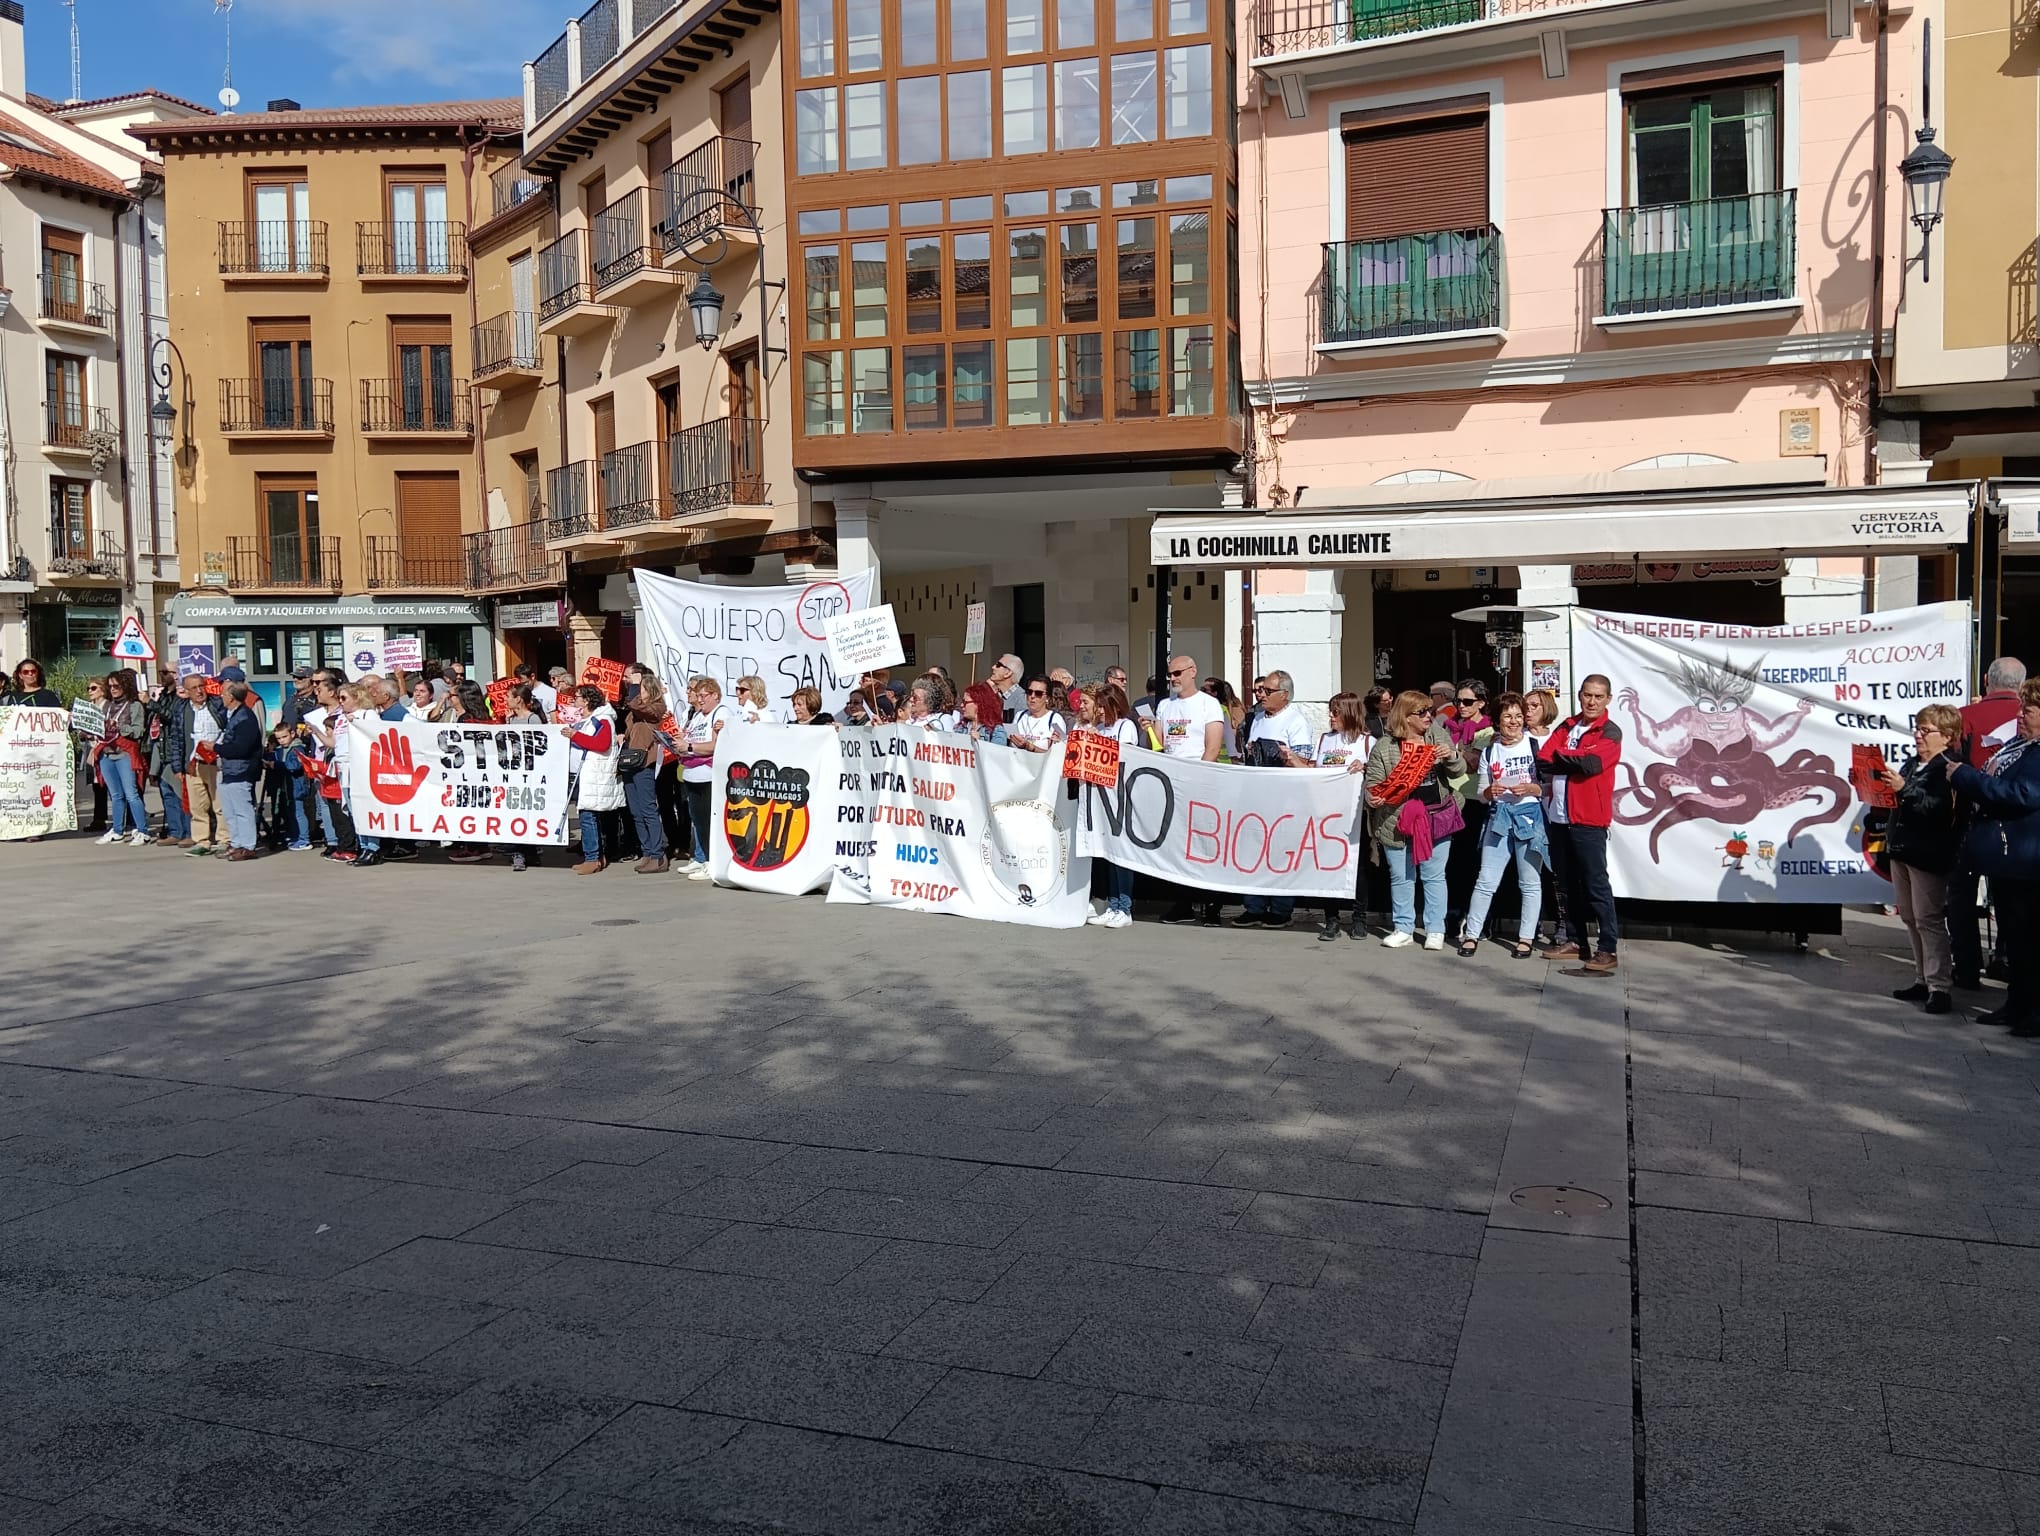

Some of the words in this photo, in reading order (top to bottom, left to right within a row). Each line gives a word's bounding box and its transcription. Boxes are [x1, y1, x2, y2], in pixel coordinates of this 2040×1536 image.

[1851, 521, 1944, 534] VICTORIA
[1859, 511, 1938, 522] CERVEZAS
[1170, 538, 1190, 557] LA
[1197, 535, 1298, 557] COCHINILLA
[1308, 532, 1391, 554] CALIENTE
[185, 606, 262, 617] COMPRA-VENTA
[263, 608, 270, 616] Y
[271, 606, 314, 617] ALQUILER
[316, 606, 327, 616] DE
[329, 606, 376, 616] VIVIENDAS,
[378, 605, 417, 616] LOCALES,
[419, 605, 448, 615] NAVES,
[449, 605, 480, 615] FINCAS
[804, 596, 843, 620] STOP
[969, 606, 984, 621] STOP
[681, 602, 786, 642] QUIERO
[1595, 616, 1697, 642] MILAGROS,
[588, 657, 599, 666] SE
[1841, 642, 1946, 666] ACCIONA
[602, 671, 620, 686] STOP
[1762, 666, 1847, 684] IBERDROLA
[1835, 684, 1861, 701] NO
[1871, 682, 1891, 700] TE
[1897, 680, 1963, 699] QUEREMOS
[15, 711, 65, 733] MACRO
[1835, 713, 1891, 730] CERCA
[437, 730, 548, 771] STOP
[840, 740, 861, 758] POR
[870, 740, 886, 758] EL
[914, 742, 976, 768] AMBIENTE
[1084, 745, 1118, 767] STOP
[1505, 755, 1532, 767] STOP
[731, 766, 748, 779] NO
[753, 768, 760, 778] A
[763, 768, 776, 780] LA
[1399, 745, 1425, 781] STOP
[441, 773, 547, 784] PLANTA
[752, 780, 788, 792] PLANTA
[790, 783, 802, 792] DE
[839, 773, 862, 792] POR
[912, 777, 956, 802] SALUD
[730, 787, 755, 797] BIOGAS
[767, 791, 802, 801] MILAGROS
[1085, 762, 1174, 850] NO
[368, 811, 549, 838] MILAGROS
[838, 805, 865, 824] POR
[930, 814, 966, 838] PARA
[1185, 800, 1350, 874] BIOGAS
[896, 843, 939, 865] HIJOS
[1780, 860, 1864, 875] BIOENERGY
